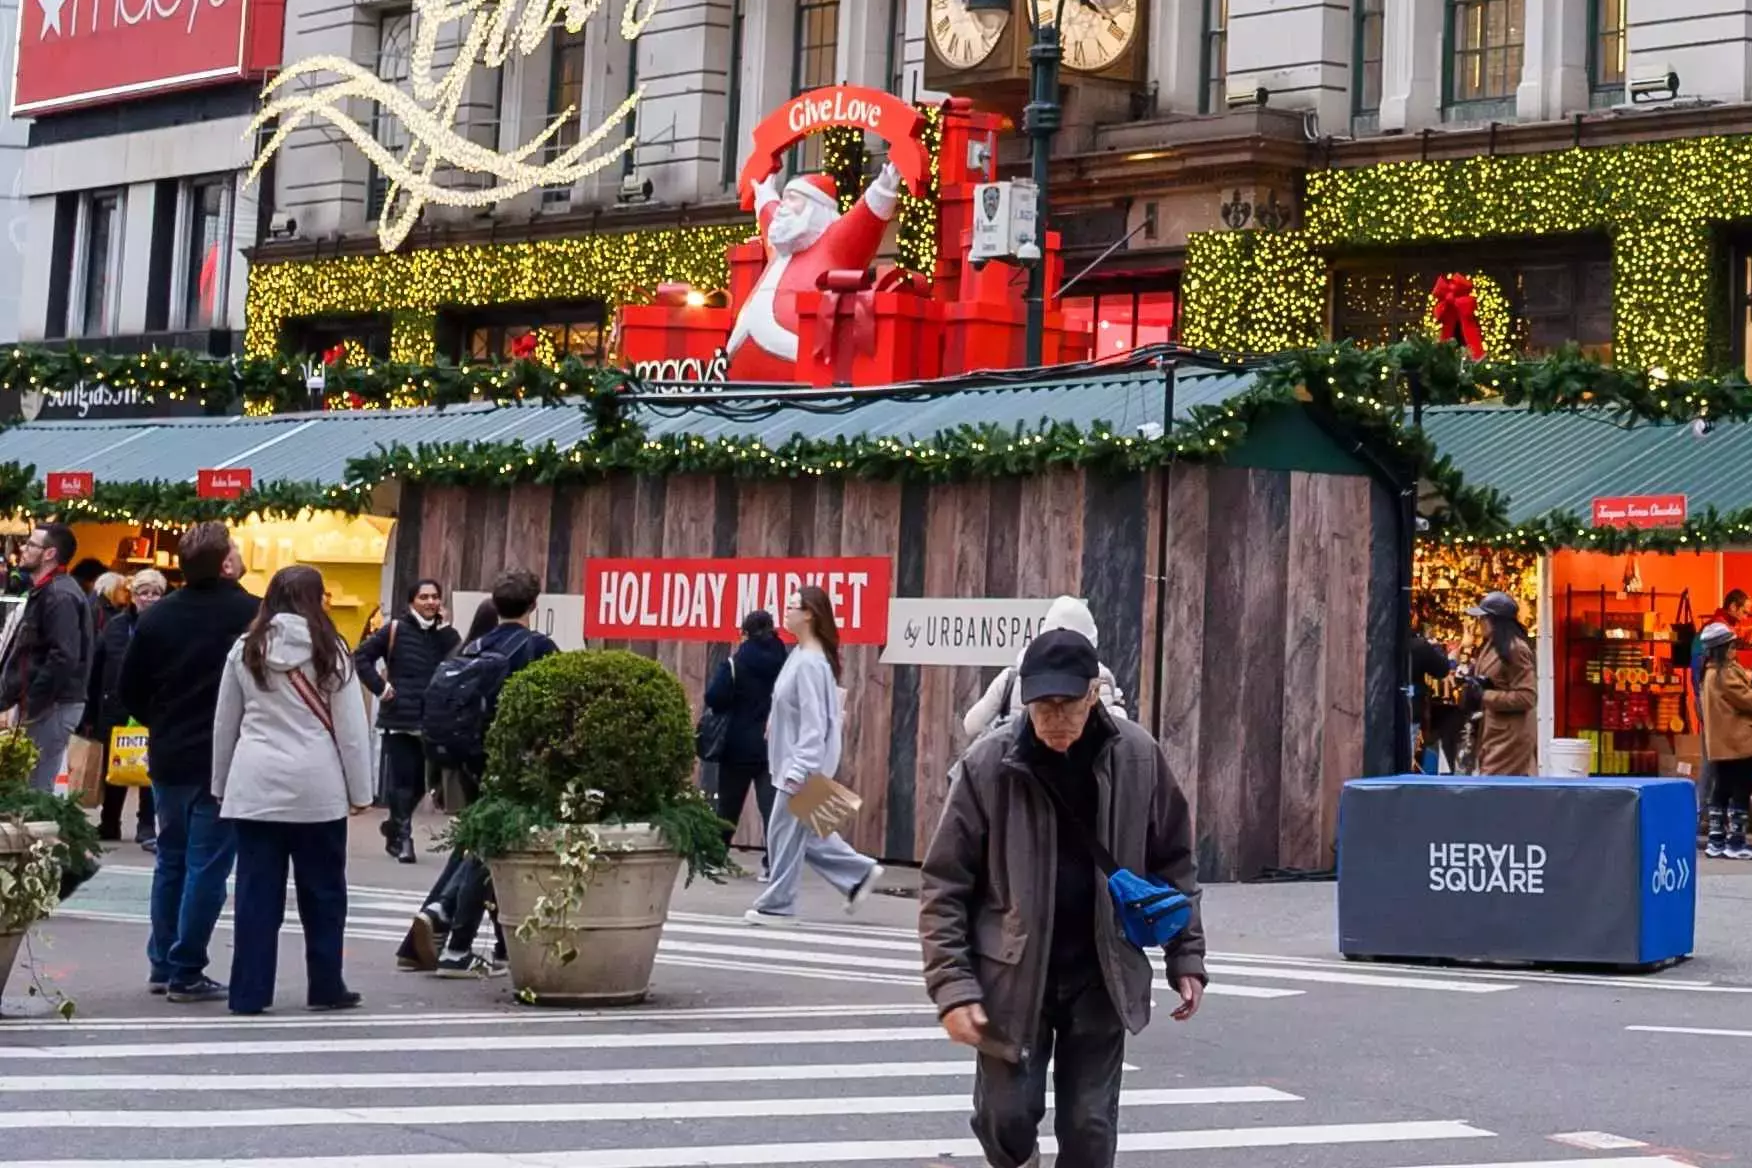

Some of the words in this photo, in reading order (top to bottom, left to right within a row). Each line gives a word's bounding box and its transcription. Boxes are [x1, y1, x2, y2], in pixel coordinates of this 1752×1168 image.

[789, 98, 832, 132] Give
[833, 92, 882, 128] Love
[636, 347, 728, 394] macy's
[599, 570, 727, 629] HOLIDAY
[904, 618, 922, 649] by
[926, 616, 1047, 648] URBANSPA
[1429, 842, 1547, 869] HERALD
[1429, 866, 1545, 894] SQUARE
